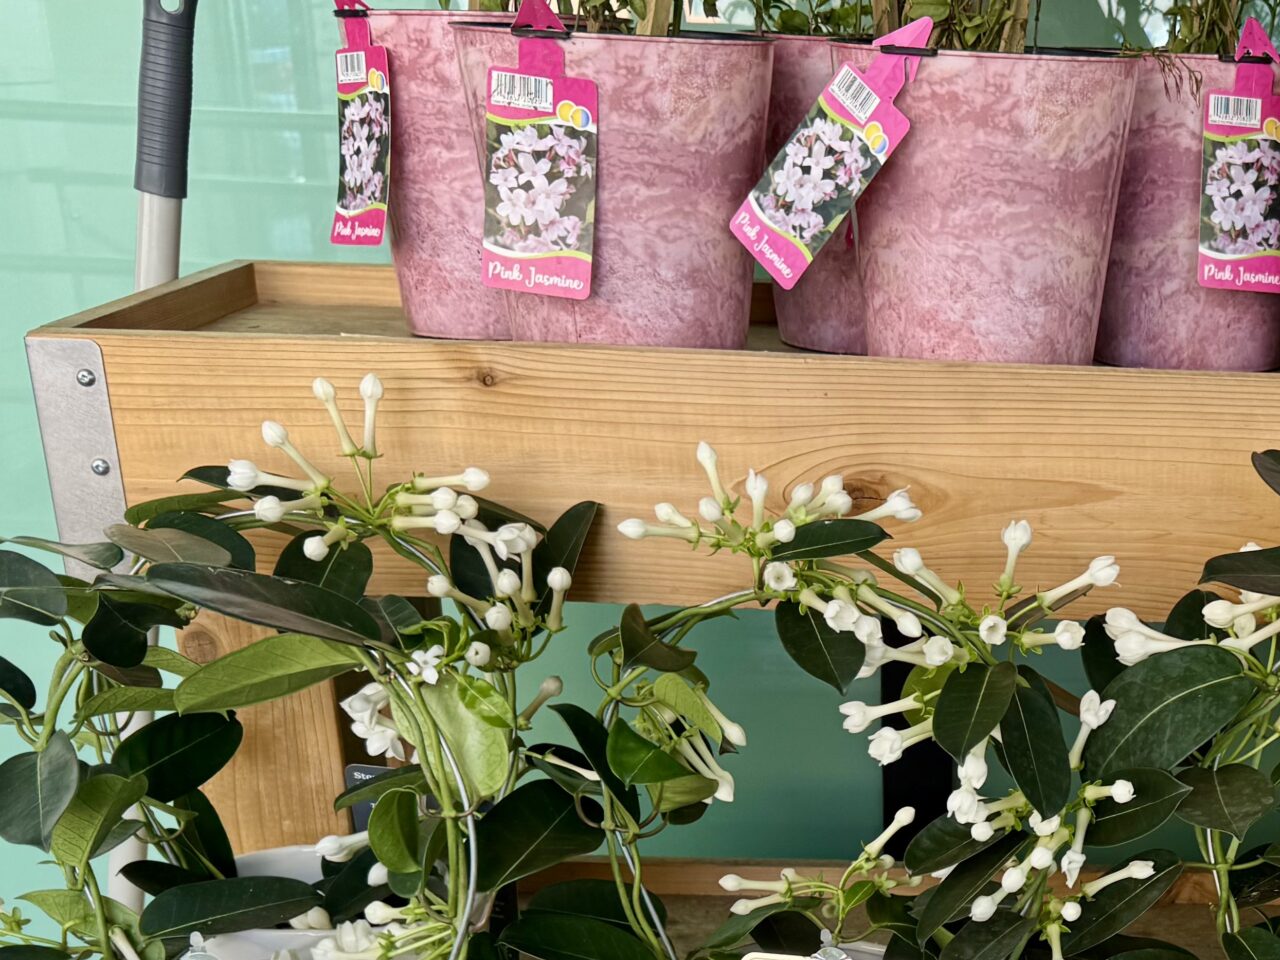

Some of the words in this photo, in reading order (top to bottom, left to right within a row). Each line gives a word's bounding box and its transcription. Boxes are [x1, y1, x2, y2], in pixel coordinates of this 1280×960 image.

[333, 220, 352, 237] Pink
[352, 221, 381, 241] Jasmine
[735, 211, 760, 241] Pink
[753, 233, 793, 279] Jasmine
[488, 261, 523, 281] Pink
[525, 266, 584, 290] Jasmine
[1204, 264, 1234, 281] Pink
